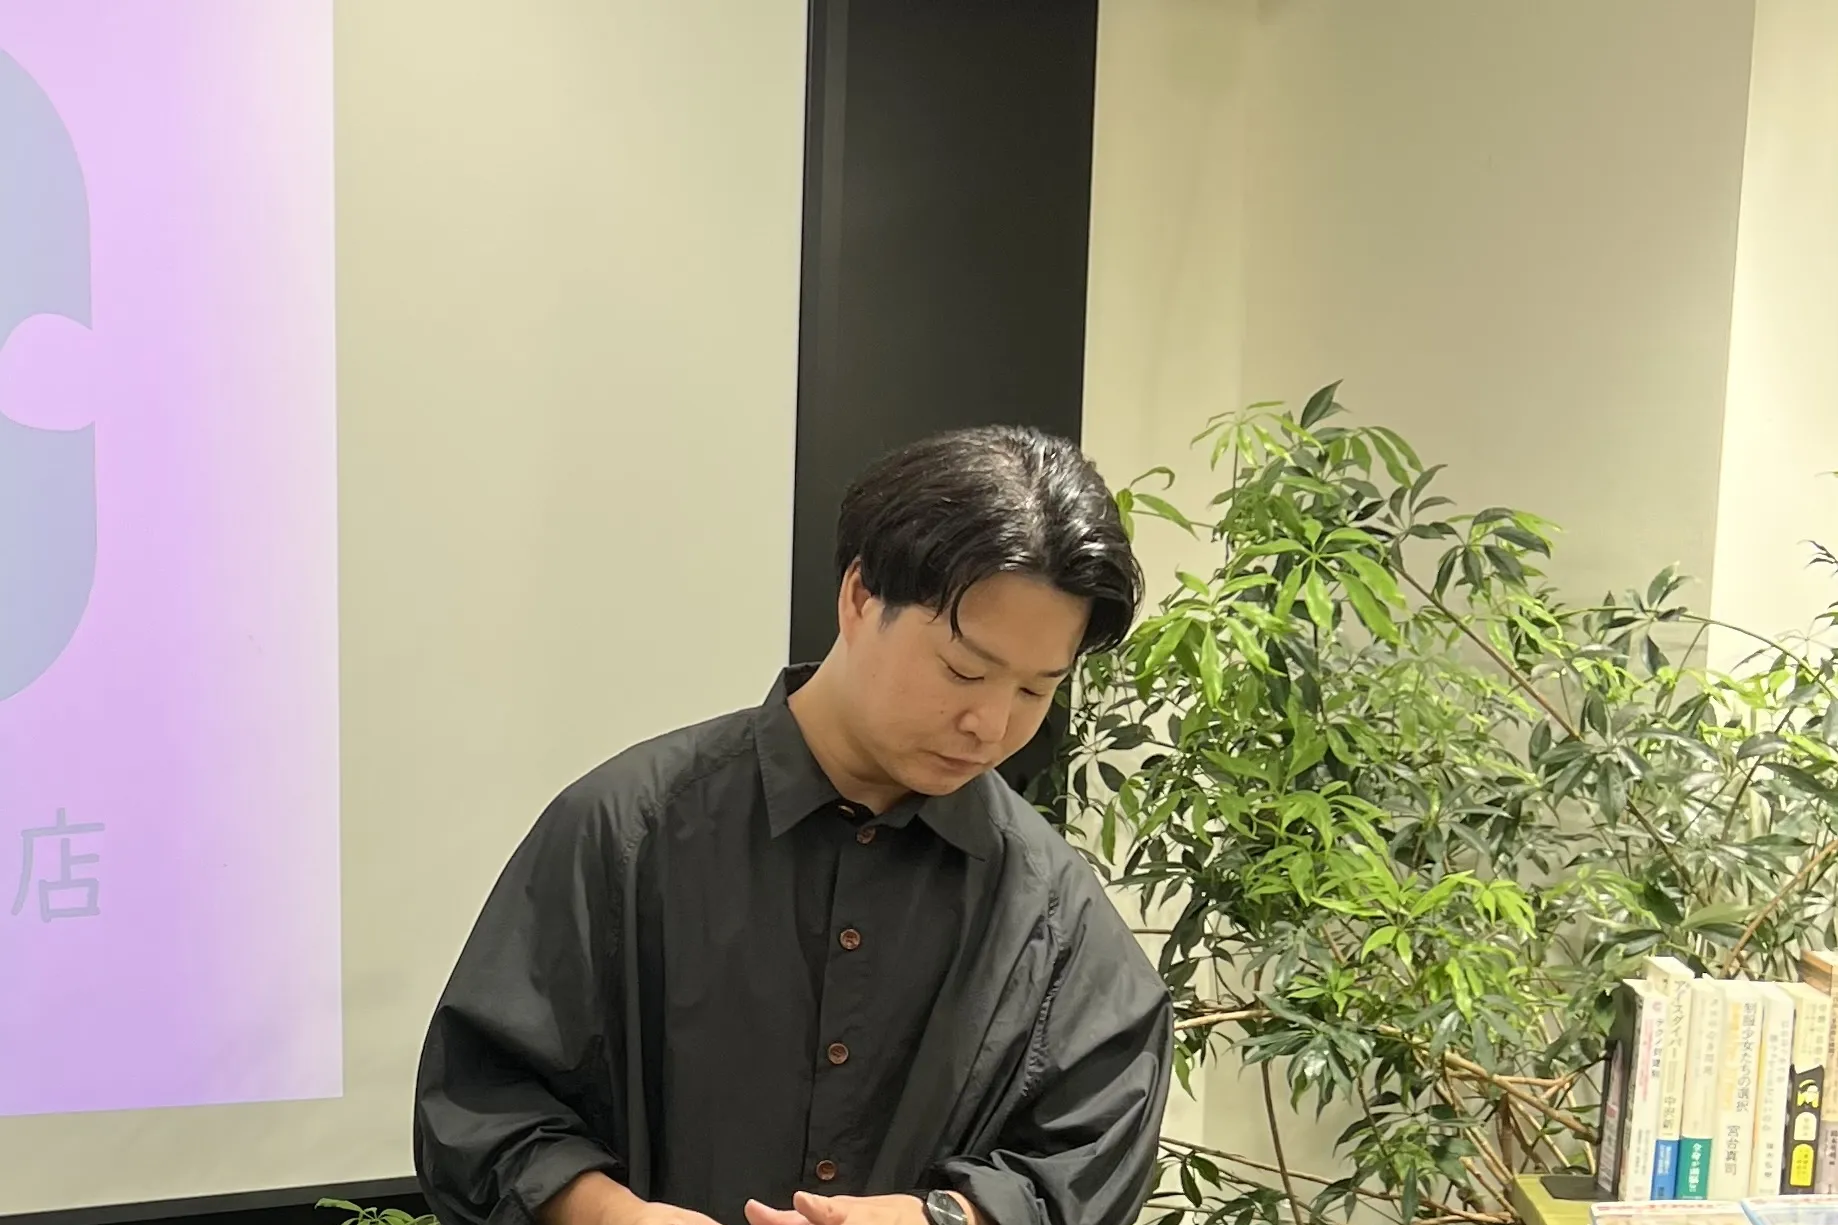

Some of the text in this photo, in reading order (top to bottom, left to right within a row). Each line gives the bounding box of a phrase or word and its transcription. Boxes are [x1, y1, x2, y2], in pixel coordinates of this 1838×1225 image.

[11, 807, 105, 923] 店
[1724, 1124, 1741, 1176] 宮台真司
